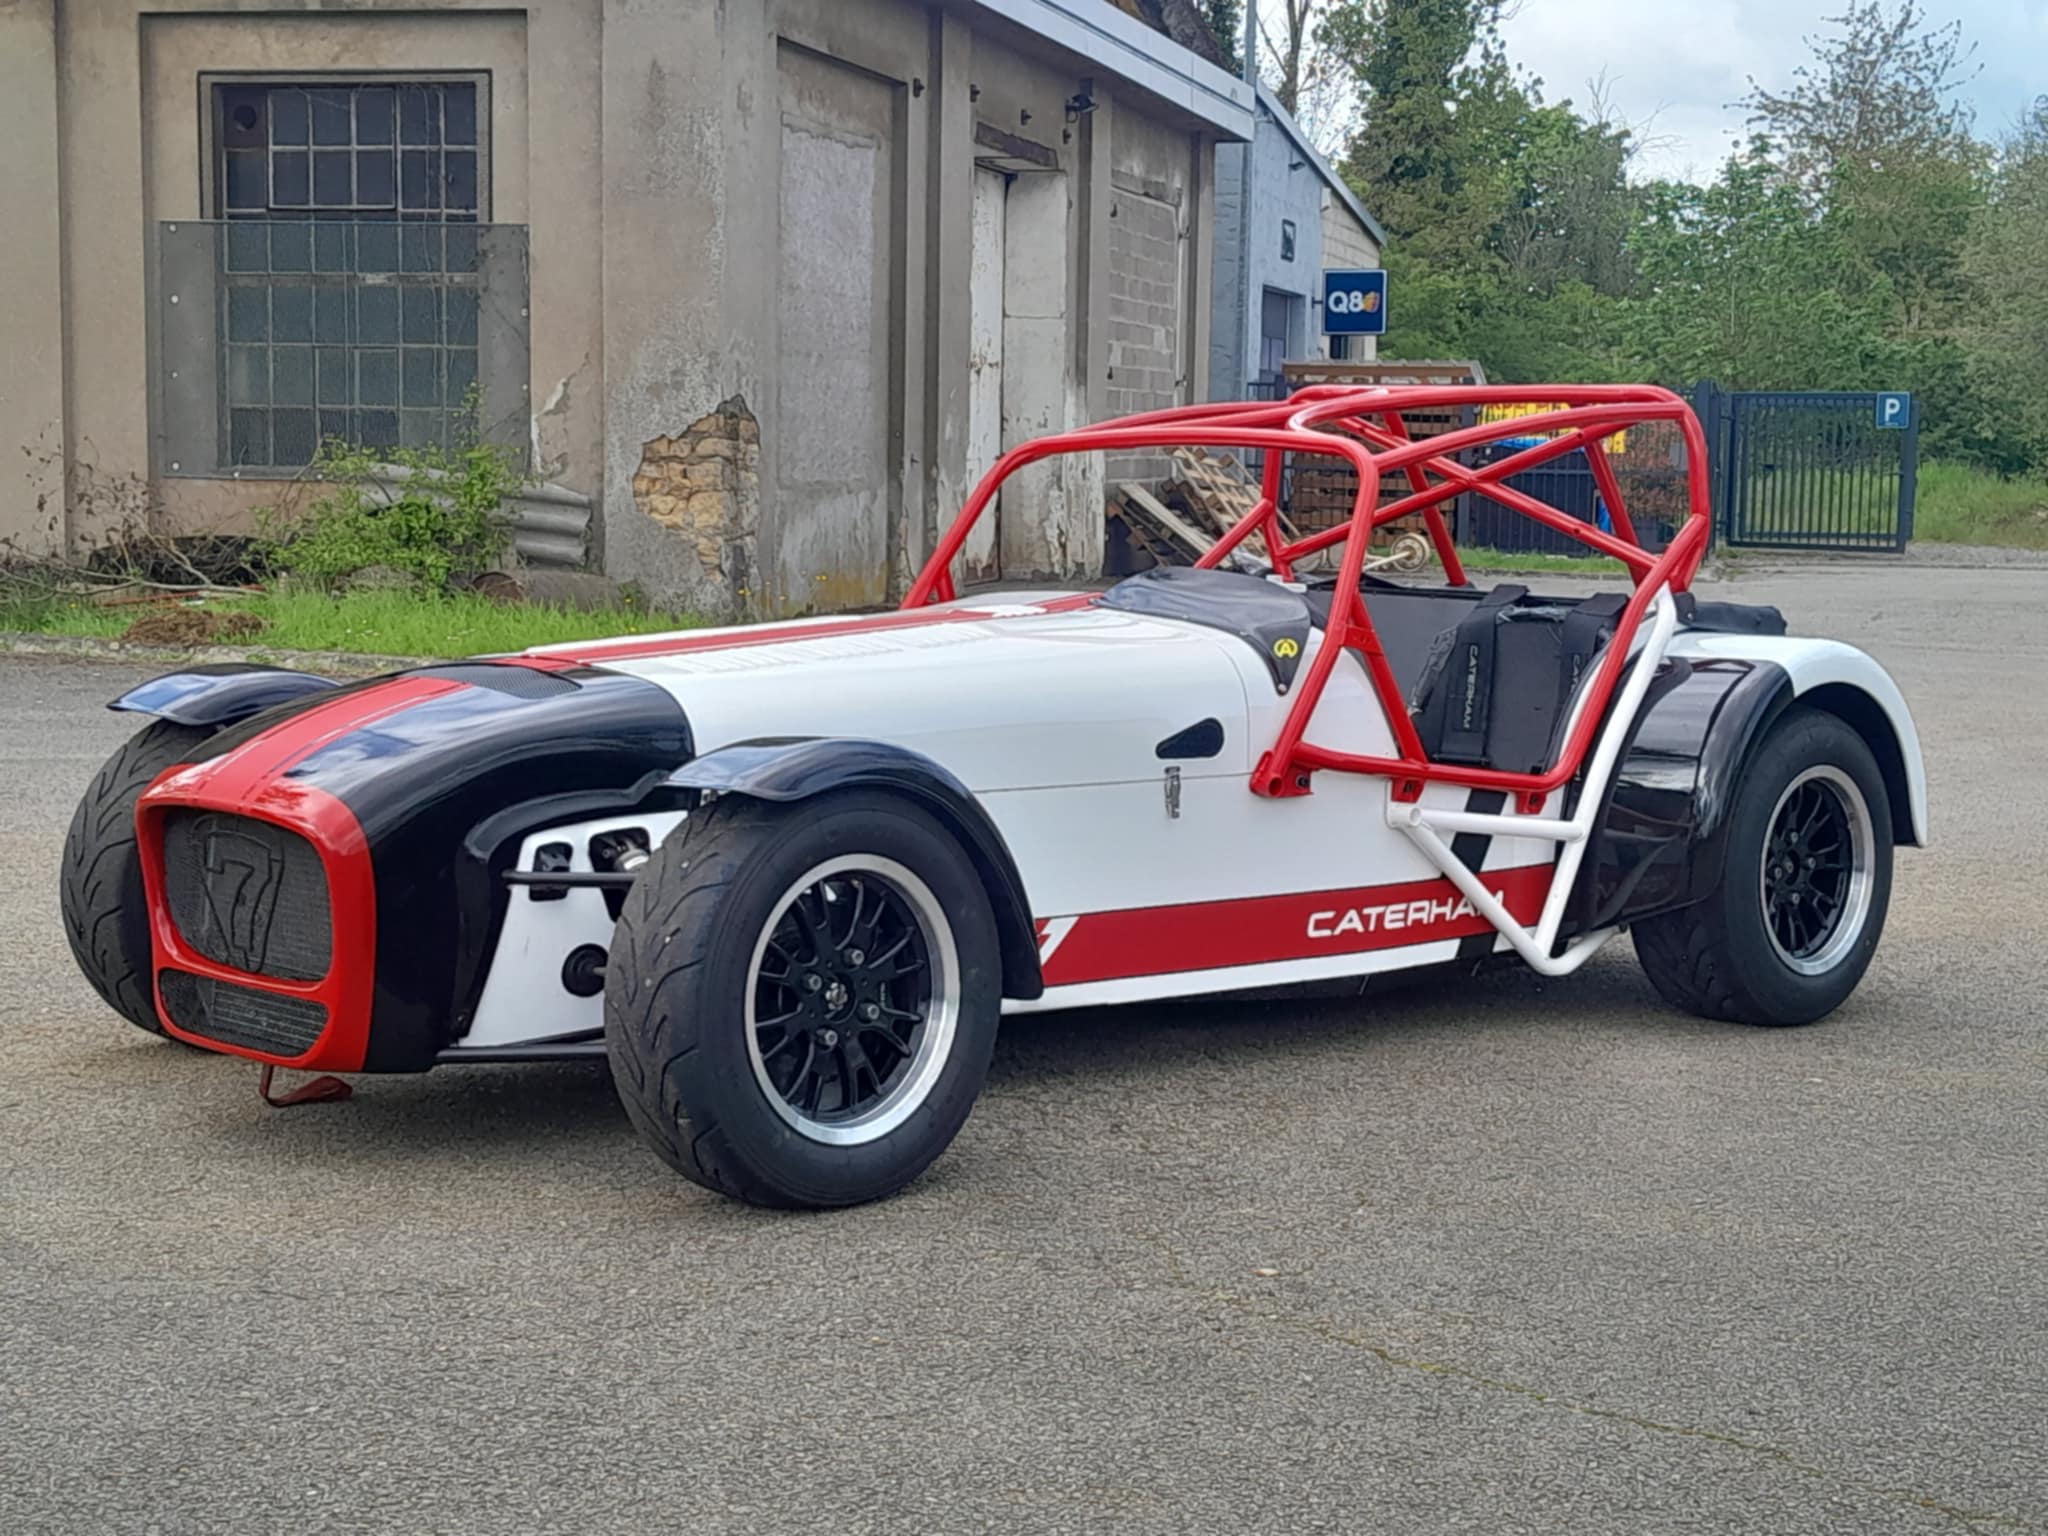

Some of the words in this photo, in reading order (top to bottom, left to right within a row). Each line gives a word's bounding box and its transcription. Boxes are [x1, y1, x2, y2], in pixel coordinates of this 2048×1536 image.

[1328, 290, 1363, 314] Q8
[1885, 398, 1900, 422] P
[1306, 890, 1504, 938] CATERHA
